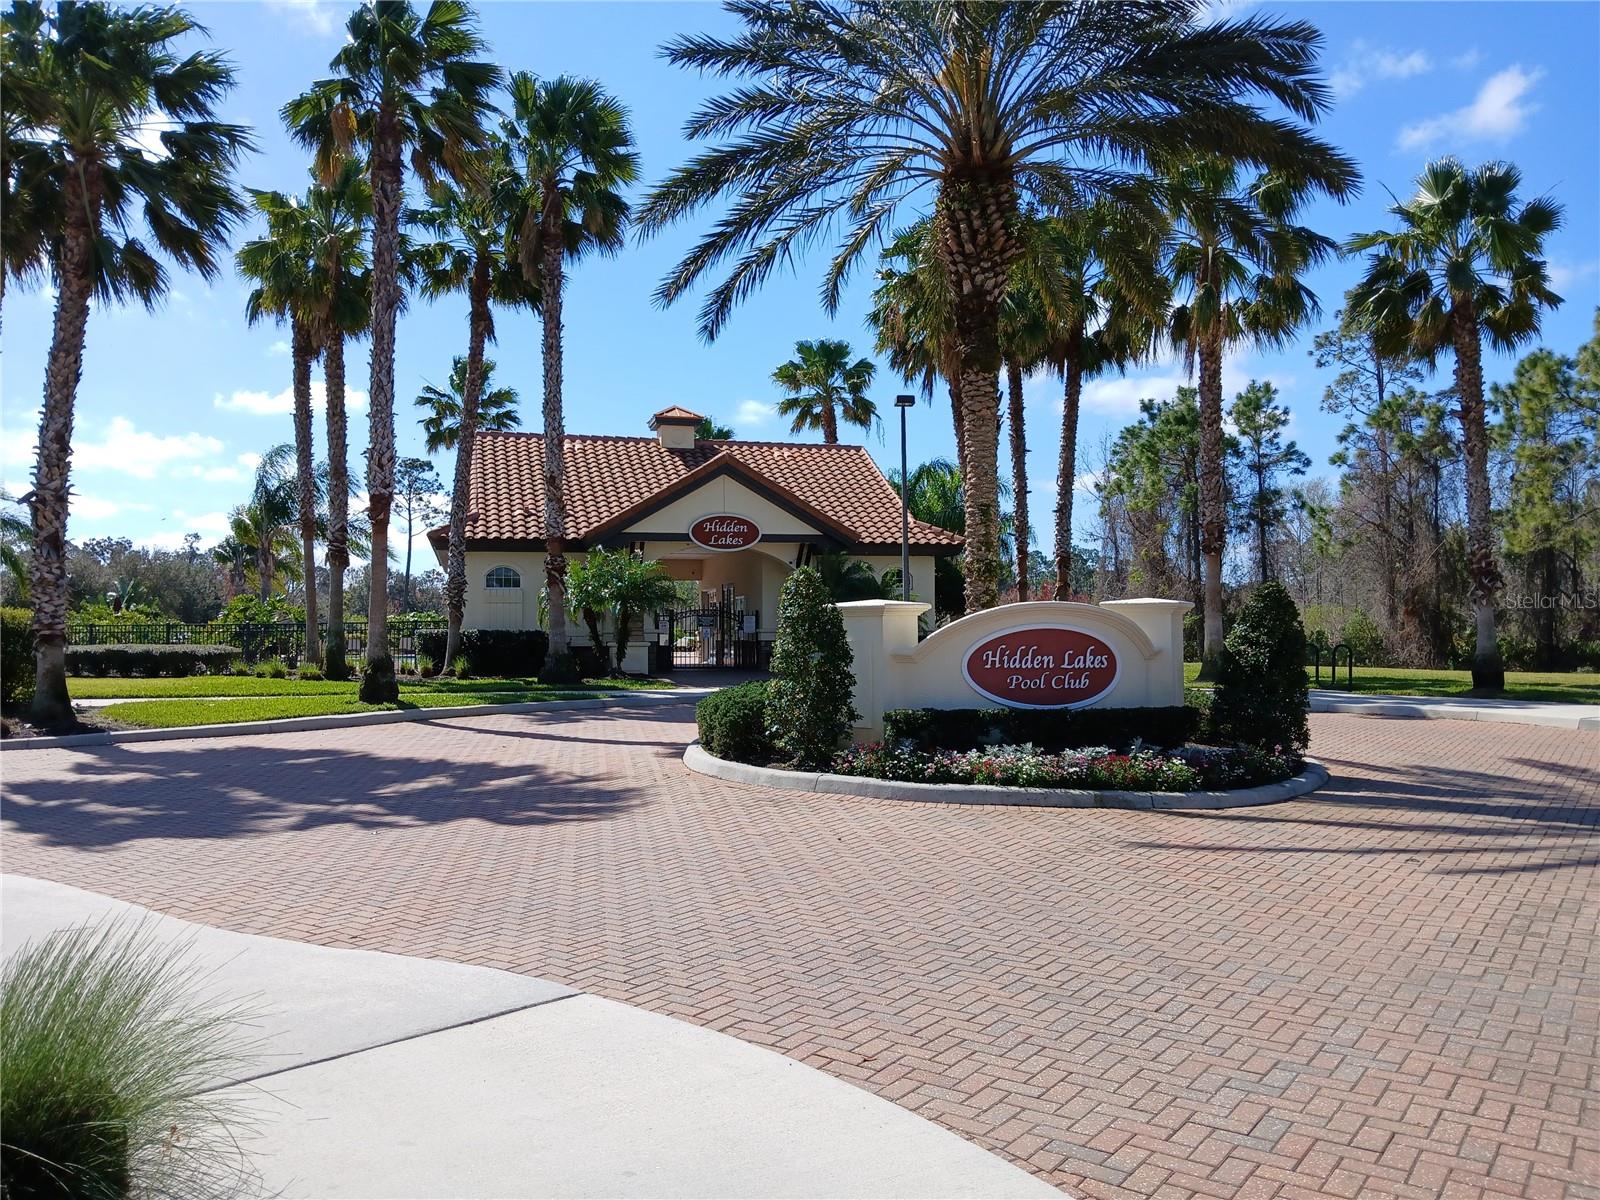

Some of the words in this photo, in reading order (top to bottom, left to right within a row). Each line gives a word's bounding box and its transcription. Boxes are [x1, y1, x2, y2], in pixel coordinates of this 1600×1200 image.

[703, 519, 748, 532] Hidden
[708, 533, 743, 545] Lakes
[983, 645, 1054, 669] Hidden
[1061, 646, 1108, 669] Lakes
[1007, 672, 1049, 689] Pool
[1052, 672, 1090, 689] Club
